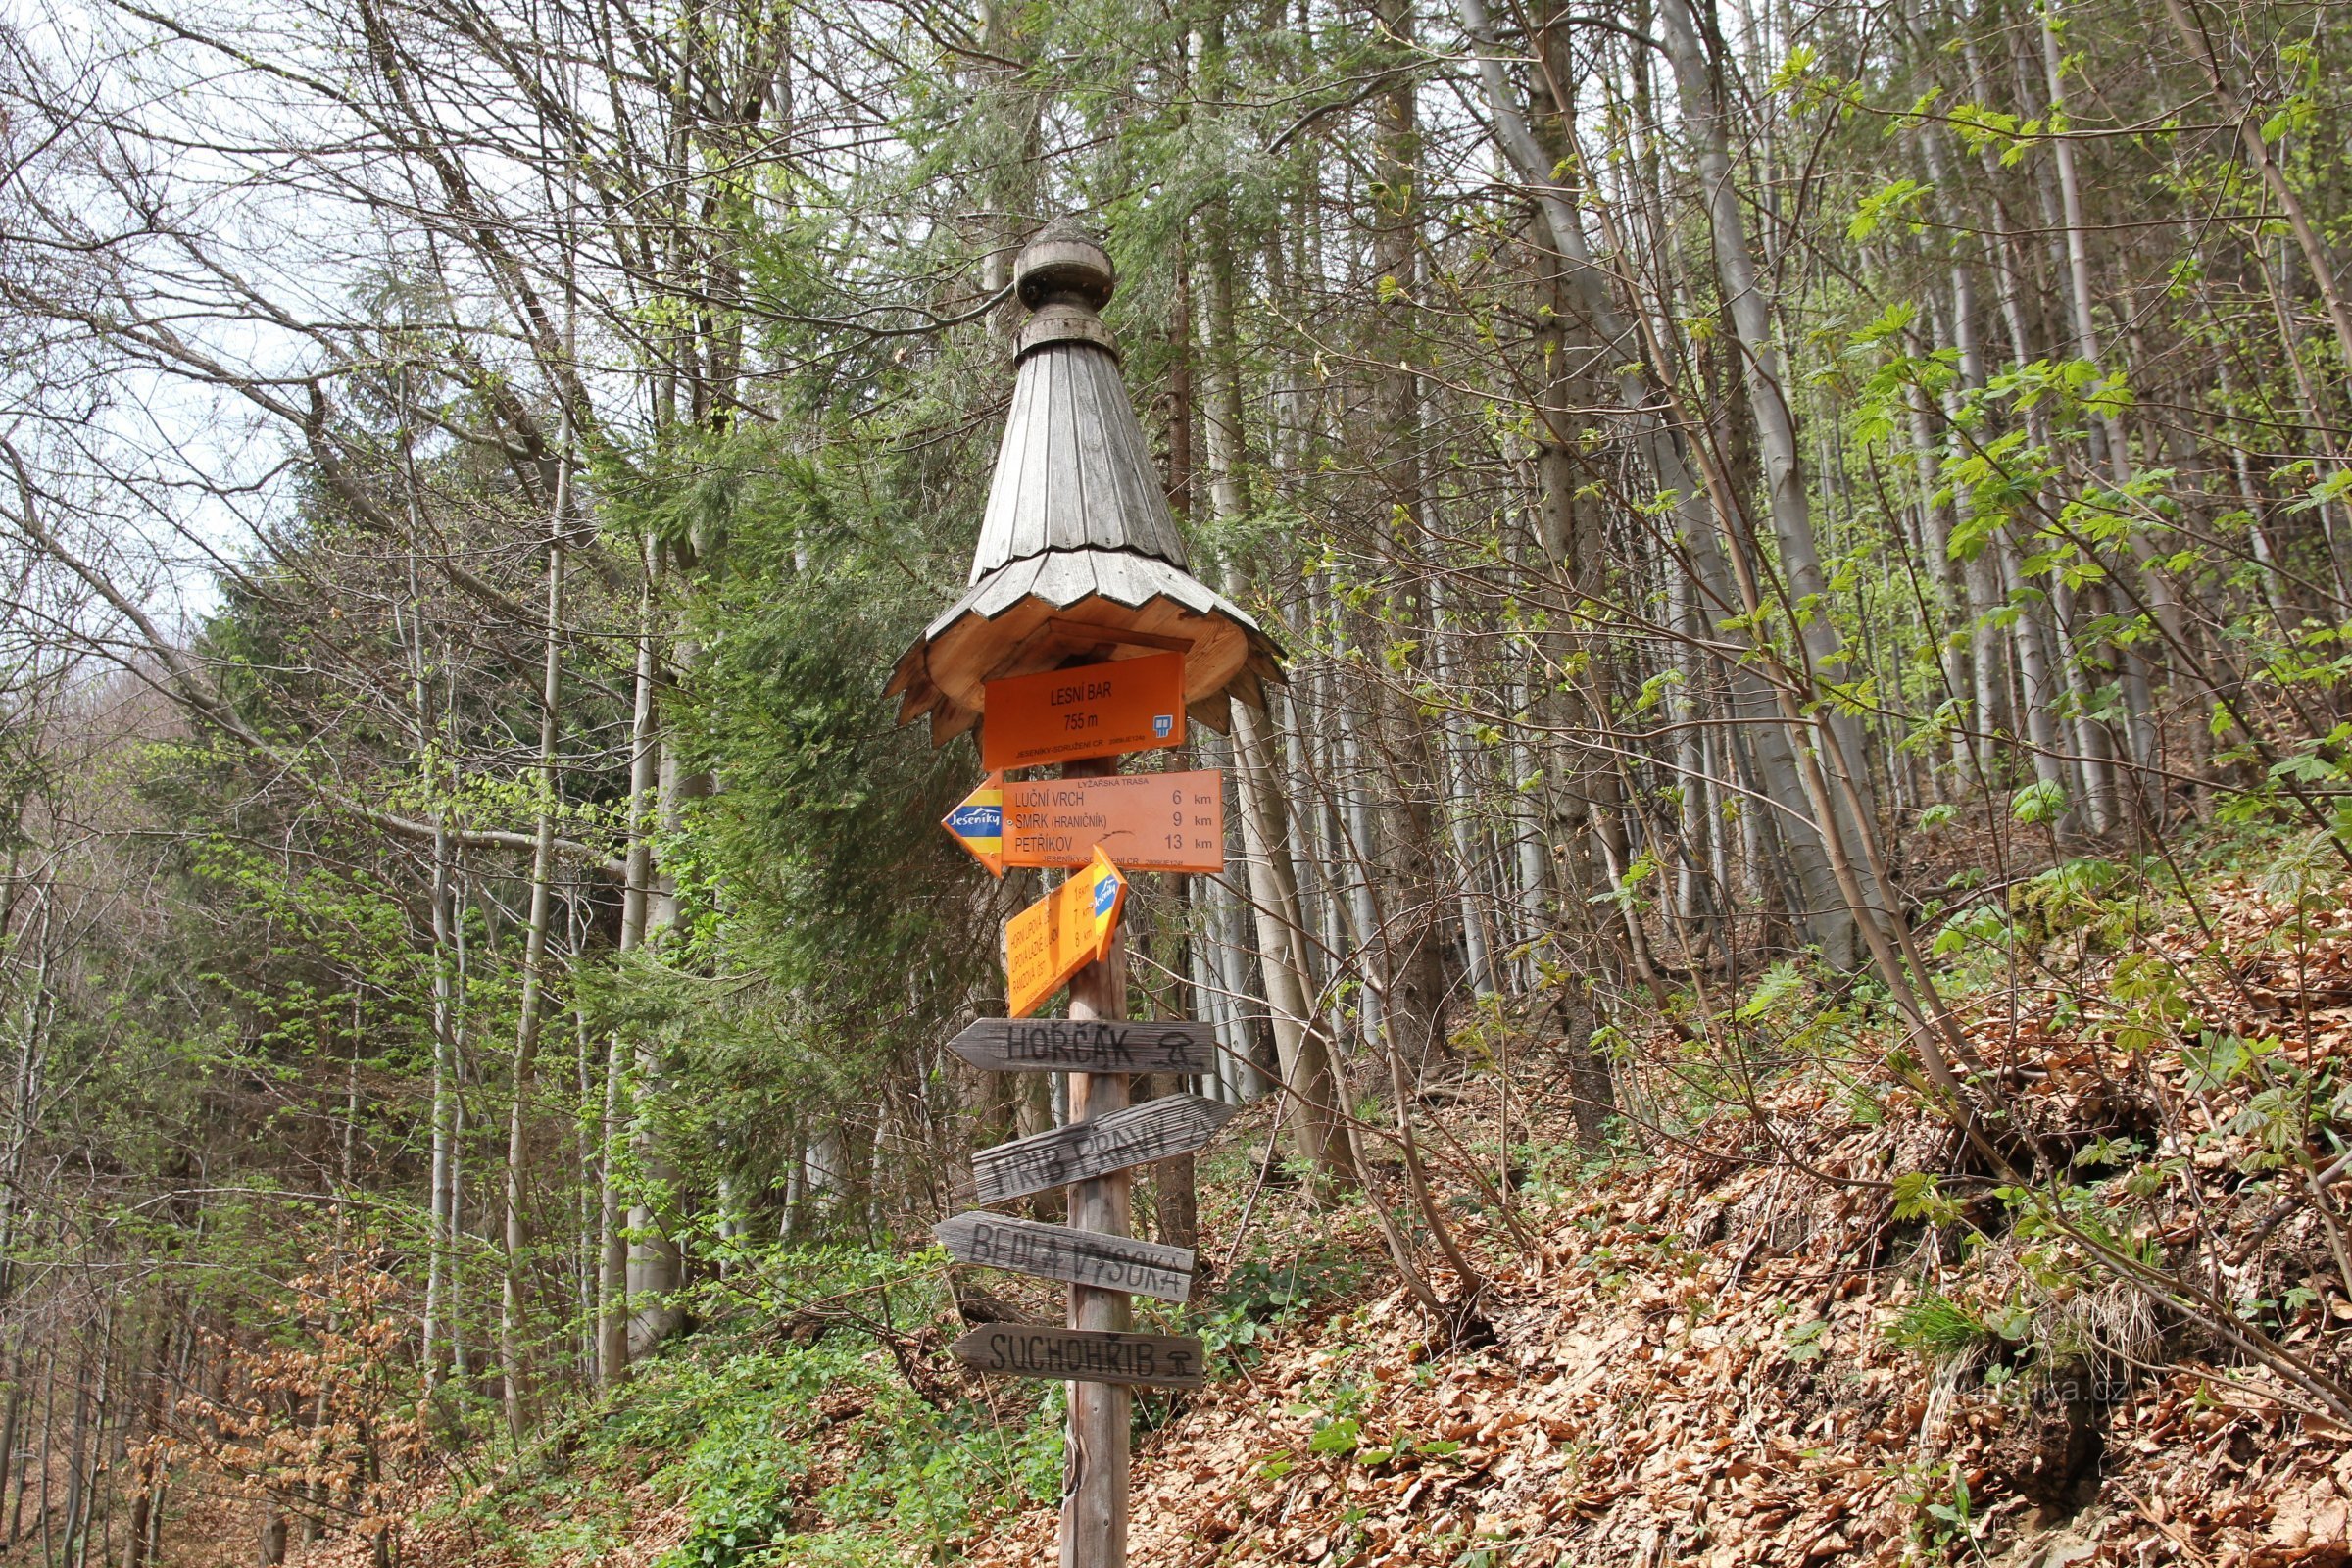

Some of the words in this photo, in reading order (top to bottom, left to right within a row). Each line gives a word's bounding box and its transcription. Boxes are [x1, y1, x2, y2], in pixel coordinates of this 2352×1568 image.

[1051, 682, 1085, 706] LESNÍ
[1088, 681, 1111, 700] BAR
[1064, 712, 1084, 731] 755
[1088, 714, 1098, 727] m
[1077, 778, 1120, 788] LYŽAŘSKÁ
[1015, 788, 1050, 807] LUČNÍ
[1052, 791, 1084, 807] VRCH
[1172, 789, 1182, 805] 6
[1194, 794, 1211, 804] km
[951, 814, 1000, 828] Jeseníky
[1015, 813, 1049, 829] SMRK
[1052, 813, 1107, 831] (HRANIČNÍK)
[1172, 811, 1182, 827] 9
[1195, 815, 1212, 826] km
[1015, 833, 1072, 853] PETŘÍKOV
[1164, 834, 1183, 850] 13
[1195, 838, 1212, 849] km
[969, 1223, 1063, 1277] BEDLA
[990, 1333, 1156, 1377] SUCHOHŘIB
